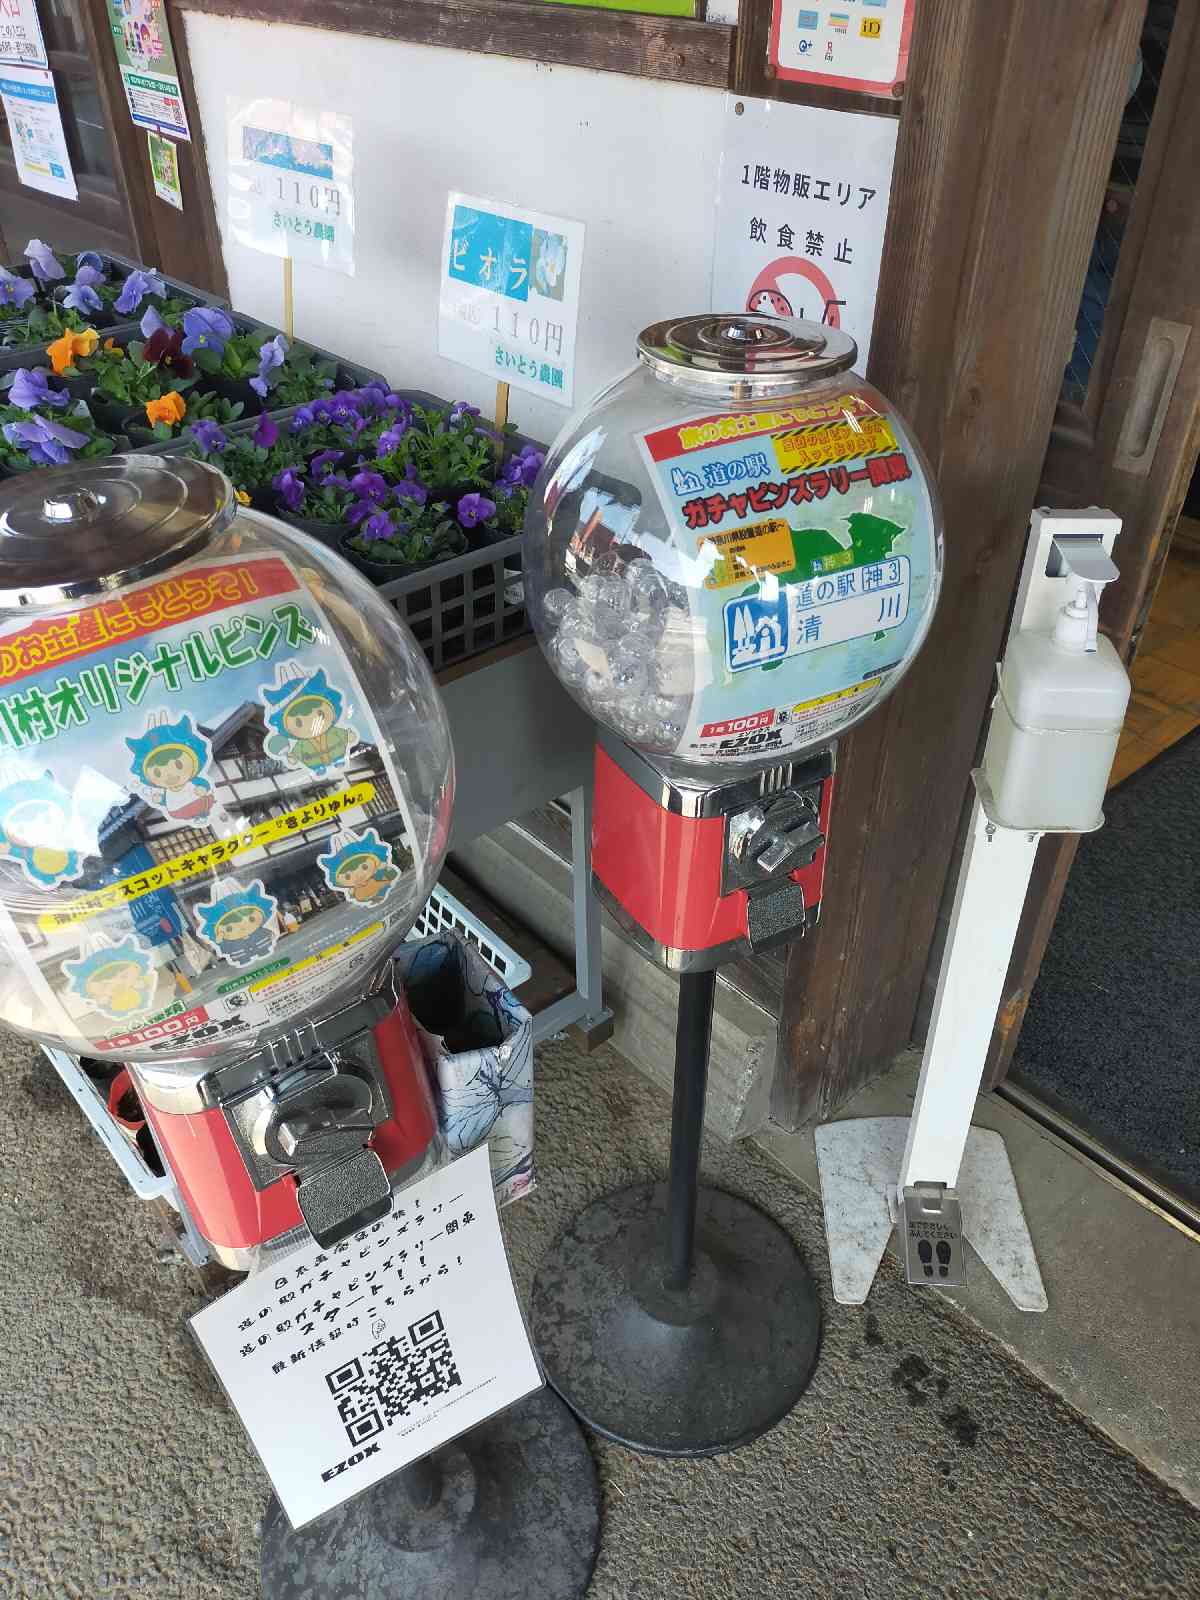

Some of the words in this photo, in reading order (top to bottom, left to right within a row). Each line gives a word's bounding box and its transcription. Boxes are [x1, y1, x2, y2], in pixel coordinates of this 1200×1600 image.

[863, 17, 880, 35] iD
[741, 164, 877, 210] 1階物販エリア
[749, 216, 853, 264] 飲食禁止
[451, 237, 529, 290] ビオラ
[493, 305, 563, 355] 110円
[704, 453, 771, 489] 道の駅
[795, 573, 855, 609] 道の駅
[320, 1442, 381, 1483] EZOX
